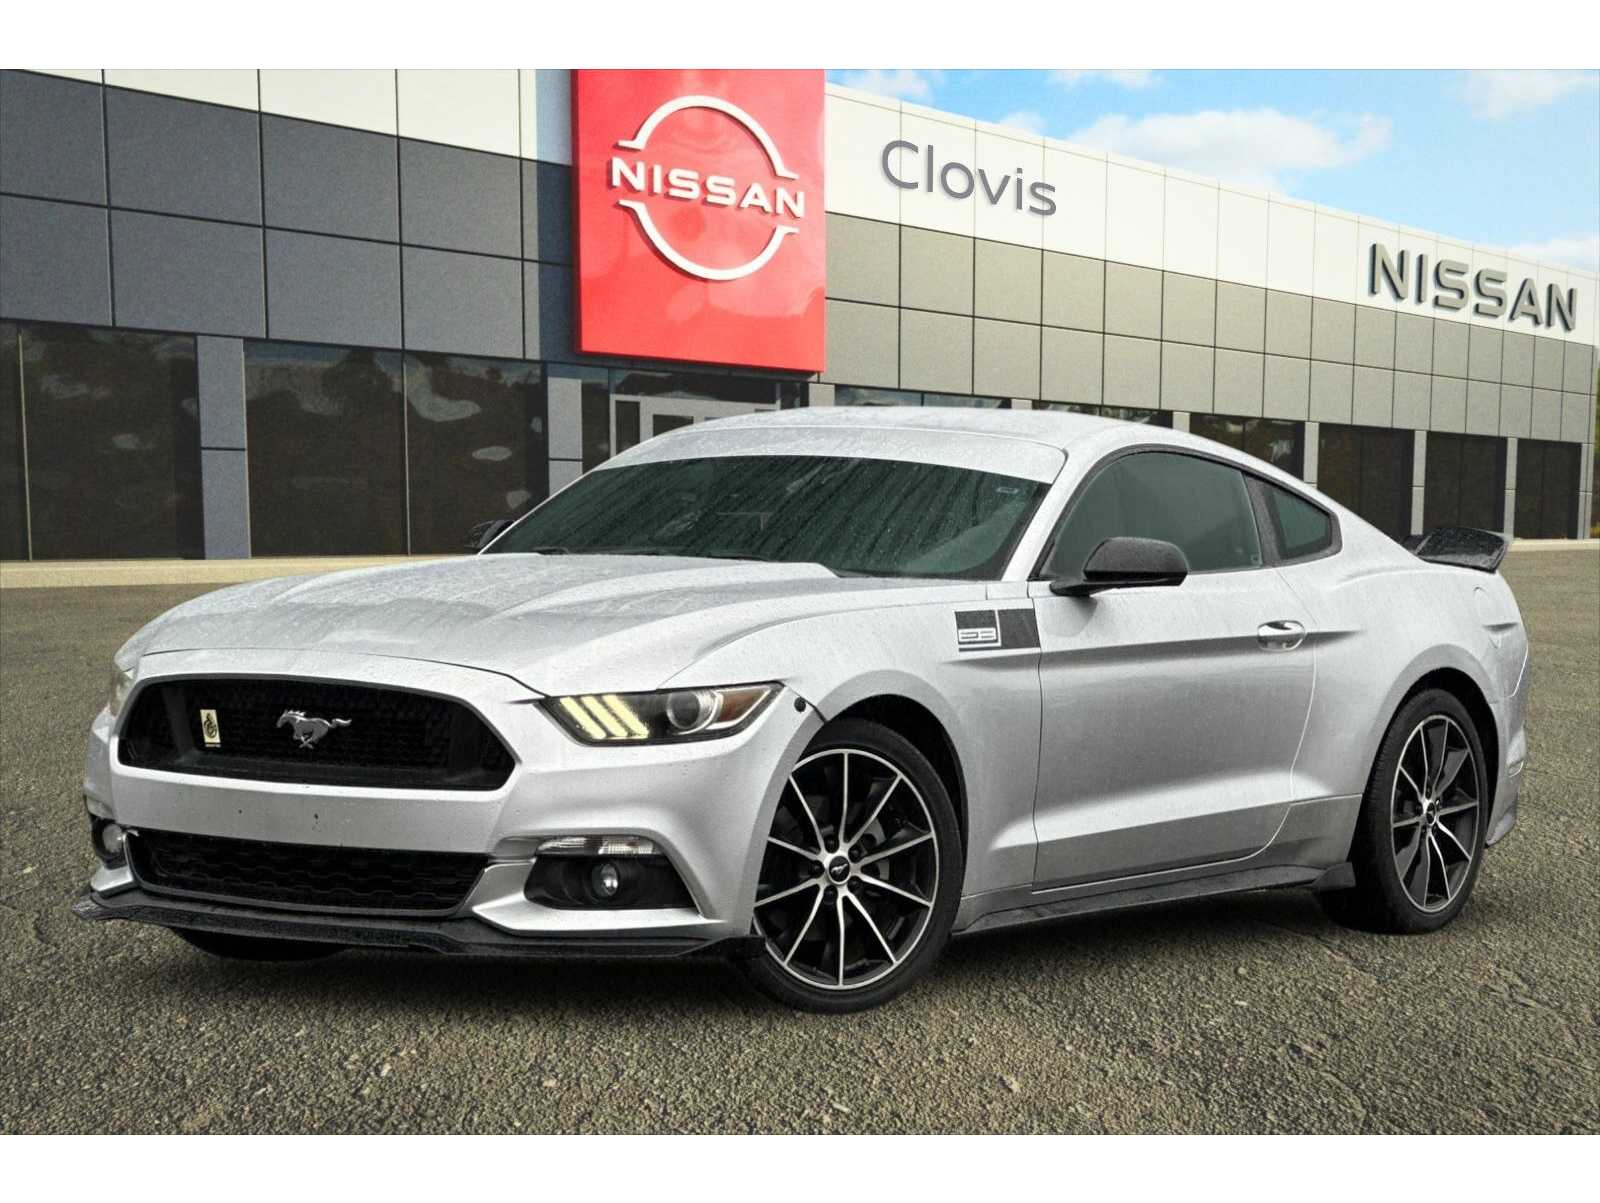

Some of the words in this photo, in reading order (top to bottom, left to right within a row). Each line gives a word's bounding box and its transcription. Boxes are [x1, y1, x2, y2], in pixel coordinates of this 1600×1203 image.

[611, 156, 805, 218] NISSAN
[882, 140, 1057, 216] Clovis
[1369, 243, 1577, 331] NISSAN
